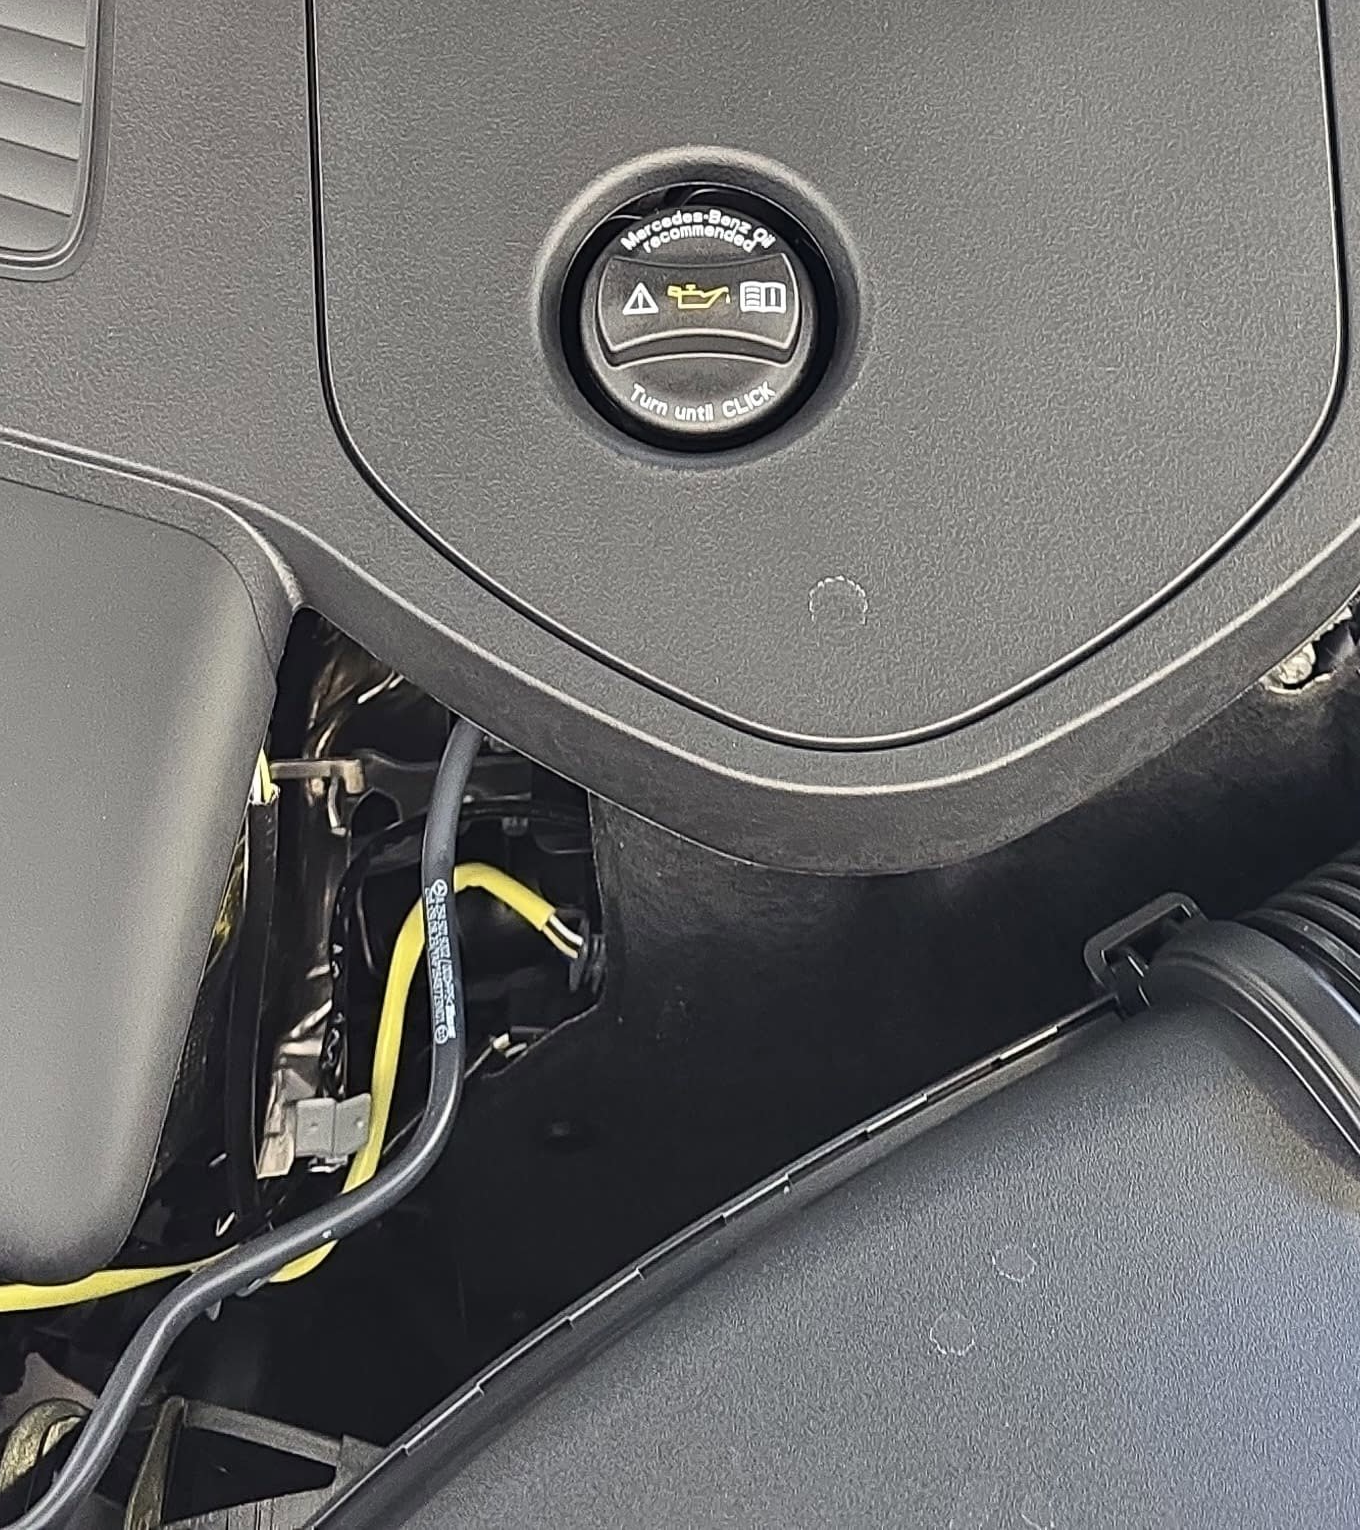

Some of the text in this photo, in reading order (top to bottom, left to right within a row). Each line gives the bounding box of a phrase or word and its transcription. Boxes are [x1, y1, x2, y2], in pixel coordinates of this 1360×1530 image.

[642, 224, 757, 253] recommended
[752, 227, 776, 249] Oil
[629, 381, 776, 421] Turn until CLICK
